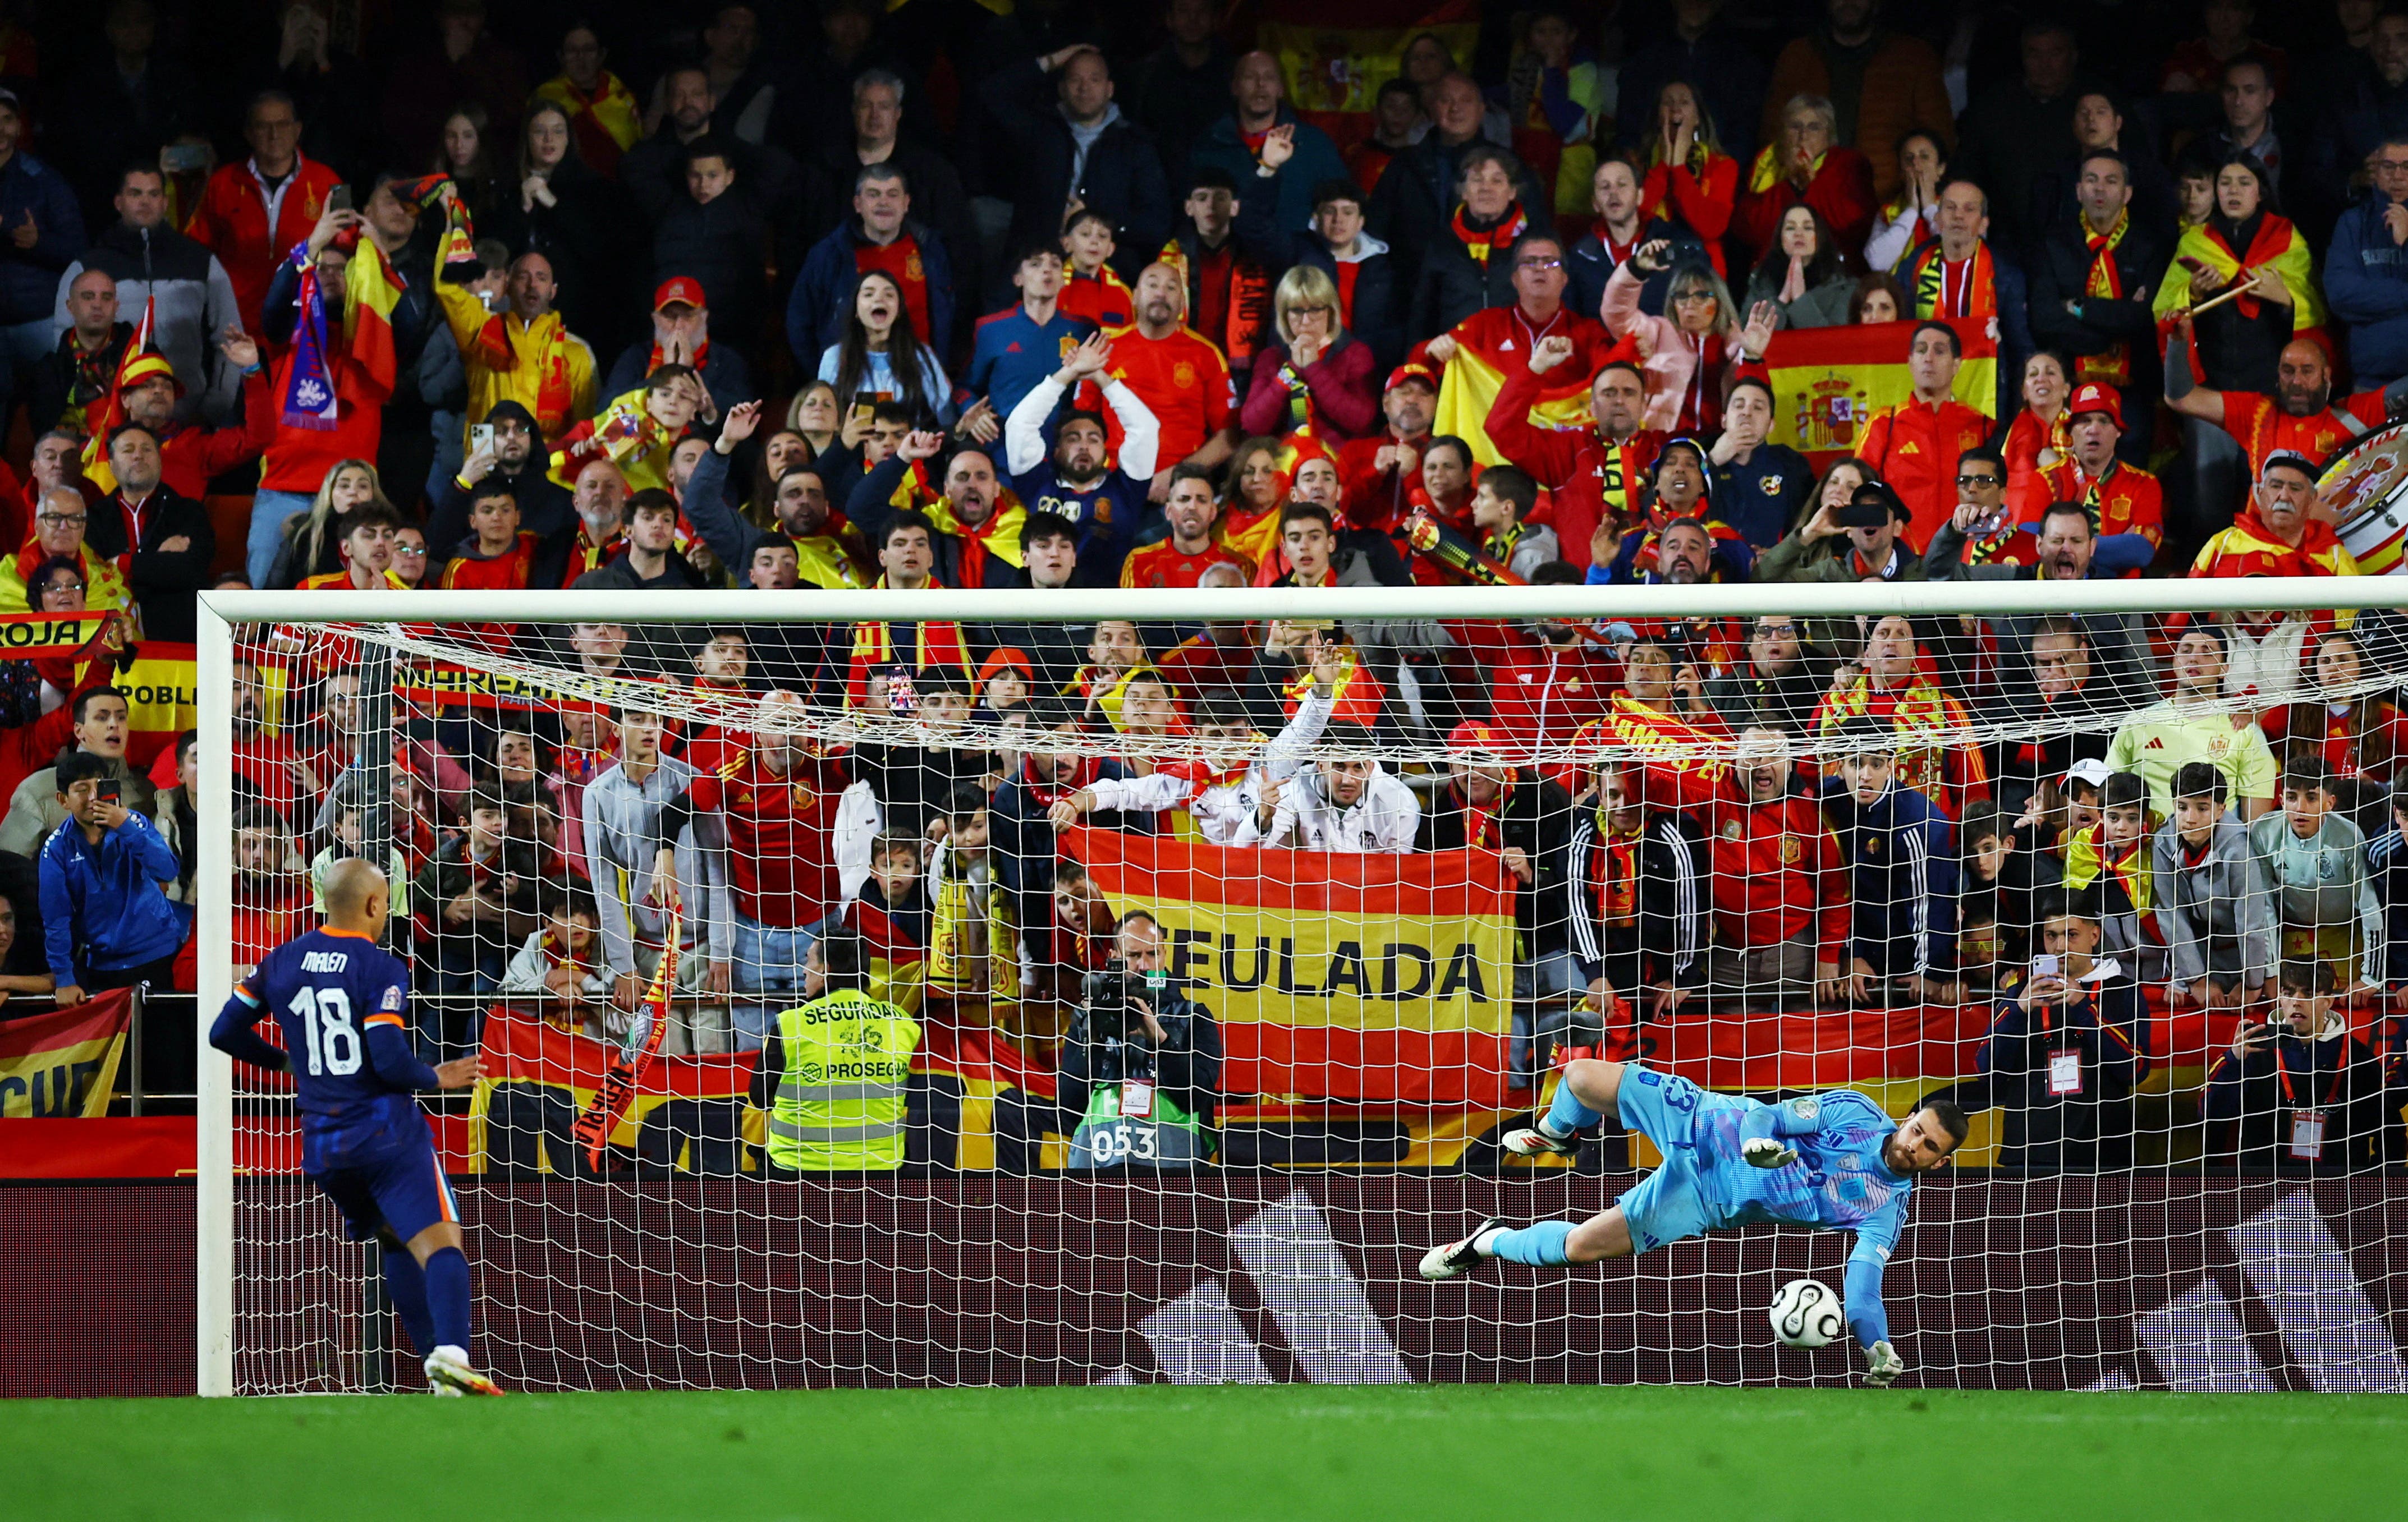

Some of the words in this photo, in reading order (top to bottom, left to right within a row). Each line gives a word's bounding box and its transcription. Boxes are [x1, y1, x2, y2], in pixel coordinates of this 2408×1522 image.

[0, 620, 81, 646] OJA
[300, 951, 348, 973] MALEN
[1161, 928, 1488, 1003] EULADA
[804, 1001, 902, 1025] SEGURIDAD
[287, 986, 363, 1076] 18
[826, 1061, 909, 1079] PROSEGUR
[1093, 1125, 1157, 1163] 053
